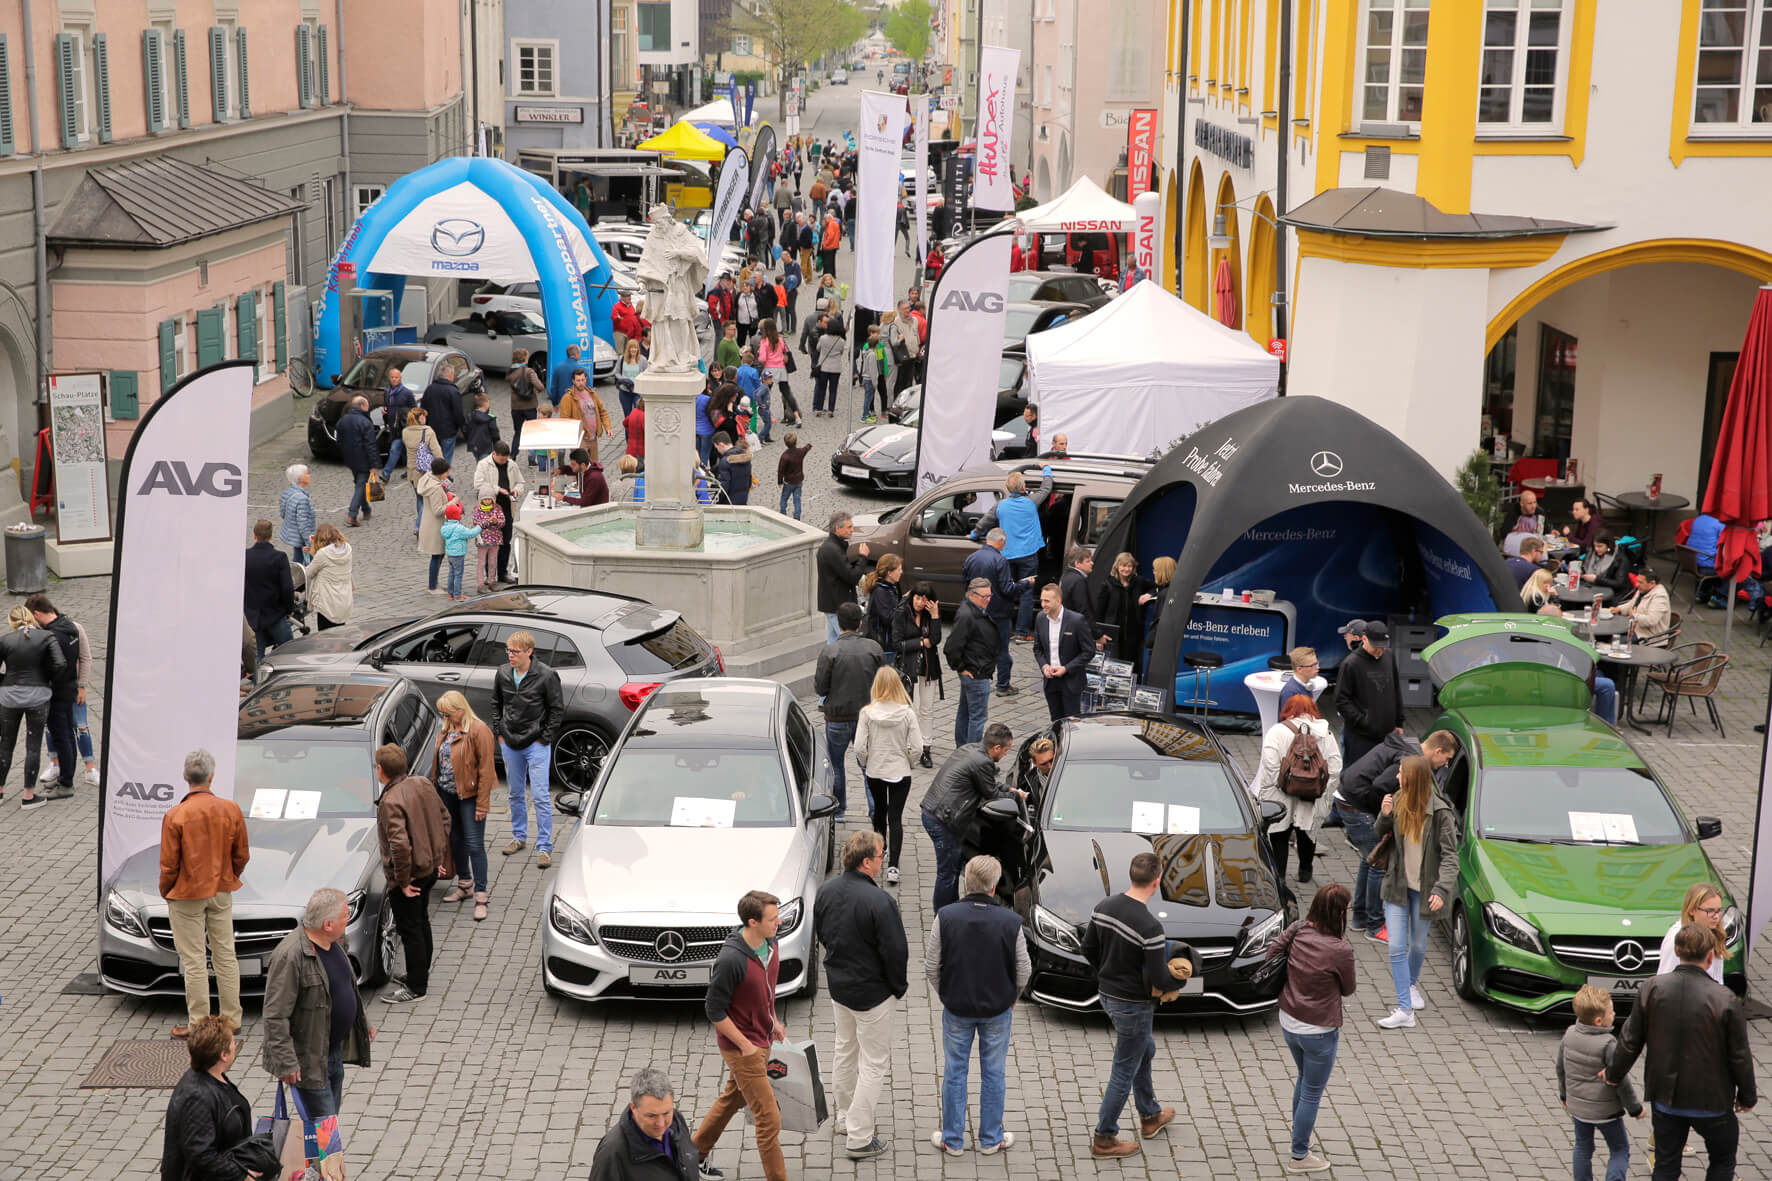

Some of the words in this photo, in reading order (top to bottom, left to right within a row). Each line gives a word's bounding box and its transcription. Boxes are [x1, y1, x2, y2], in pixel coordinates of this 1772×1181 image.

[529, 113, 570, 121] WINKLER
[1105, 112, 1128, 127] Büc
[1134, 113, 1151, 202] ISSAN
[955, 164, 964, 219] INFINITI
[1060, 220, 1122, 231] NISSAN
[1139, 216, 1154, 280] SSAN
[939, 290, 1004, 313] AVG
[1213, 437, 1240, 461] Jetzt
[1182, 447, 1209, 475] Probe
[137, 460, 243, 497] AVG
[1288, 481, 1376, 494] Mercedes-Benz
[1244, 528, 1337, 542] Mercedes-Benz
[1186, 619, 1229, 634] des-Benz
[1231, 623, 1270, 637] erleben!
[116, 782, 174, 801] AVG
[654, 969, 687, 980] AVG
[1613, 980, 1645, 990] AV
